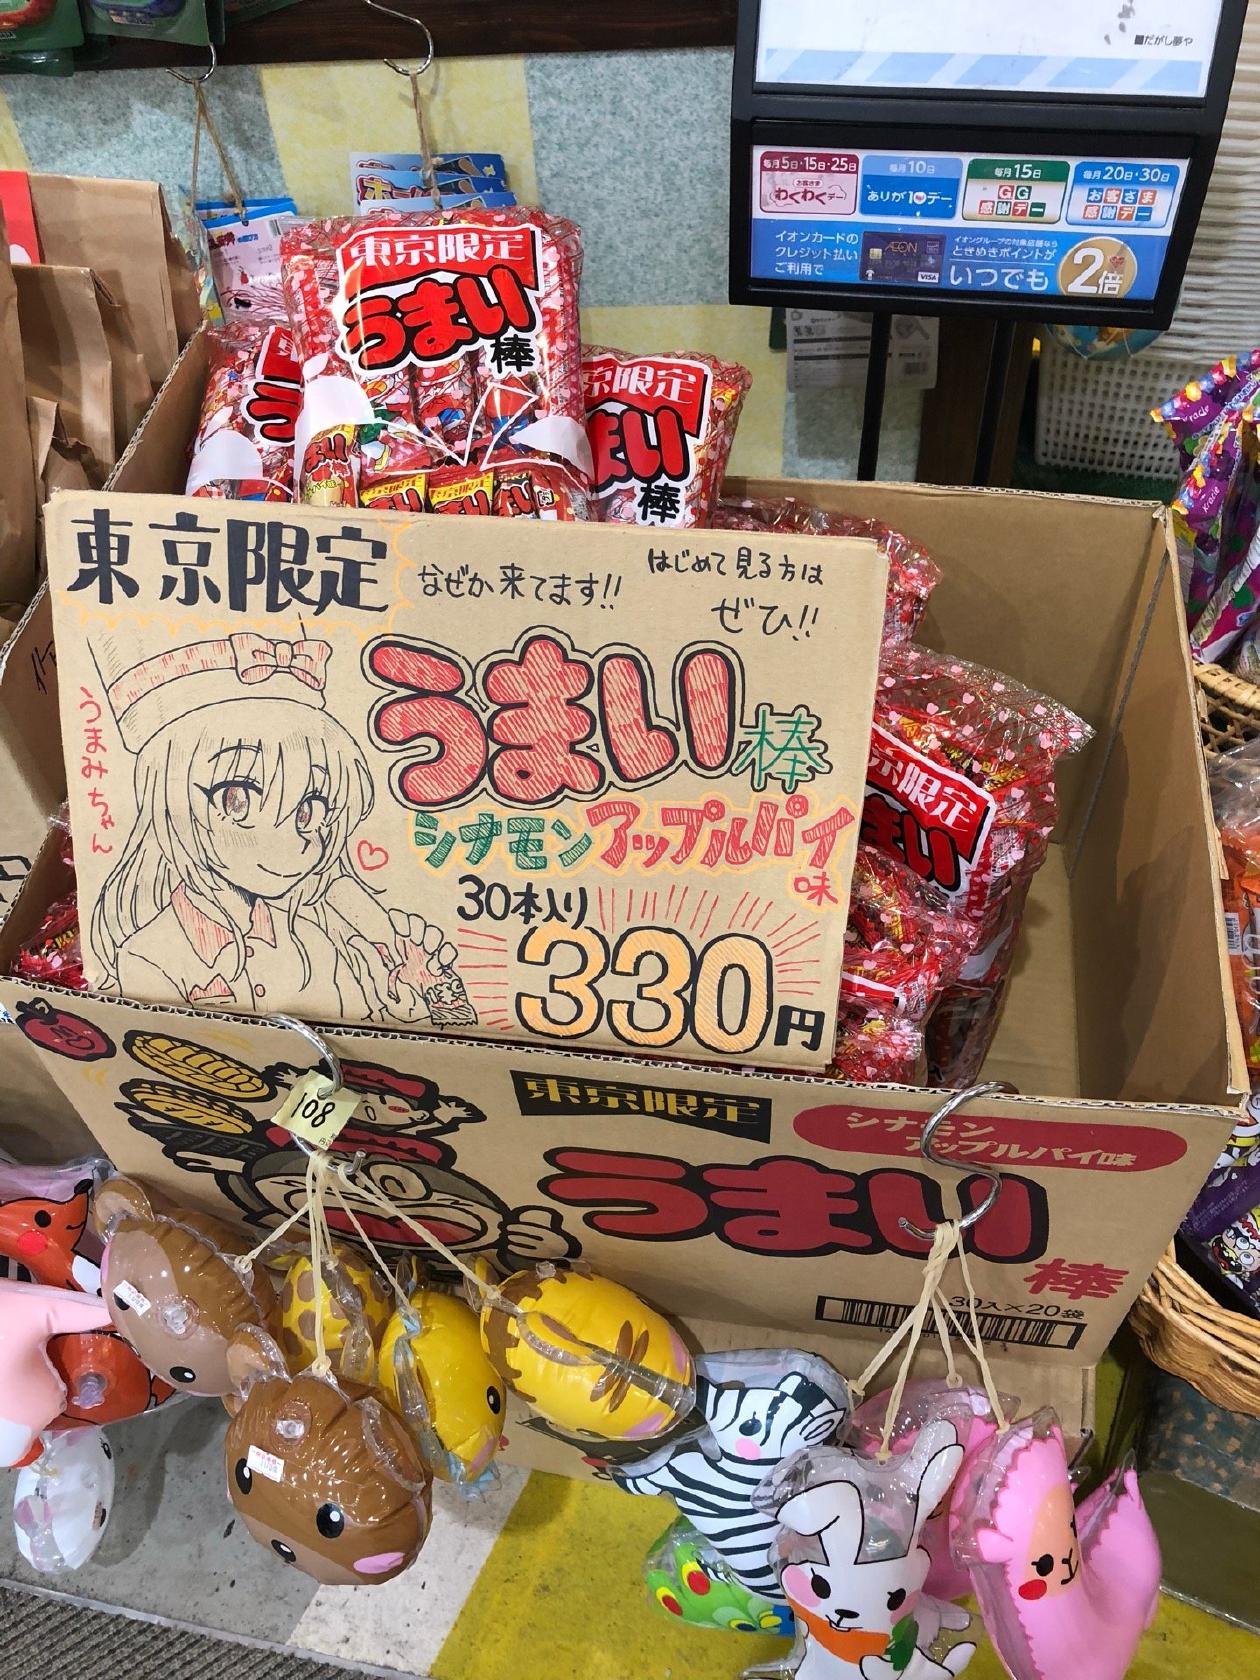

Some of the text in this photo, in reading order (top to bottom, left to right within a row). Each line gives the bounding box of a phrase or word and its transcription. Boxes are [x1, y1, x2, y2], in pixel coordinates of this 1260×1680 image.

[994, 164, 1042, 179] 毎月15日
[1088, 188, 1156, 205] お客さま
[979, 200, 1046, 217] 感謝デー
[1083, 204, 1152, 221] 感謝デー
[775, 230, 859, 245] イオンカードの
[350, 232, 526, 267] 東京限定
[775, 247, 858, 261] クレジット払い
[952, 247, 1057, 259] ときめきポイントが
[775, 262, 824, 276] ご利用で
[920, 273, 937, 281] VISA
[950, 264, 1050, 291] いつでも
[66, 509, 390, 617] 東京限定
[79, 686, 116, 855] うまみちゃん
[456, 874, 589, 930] 30本入り
[524, 1077, 761, 1124] 東京限定
[290, 1092, 336, 1128] 108
